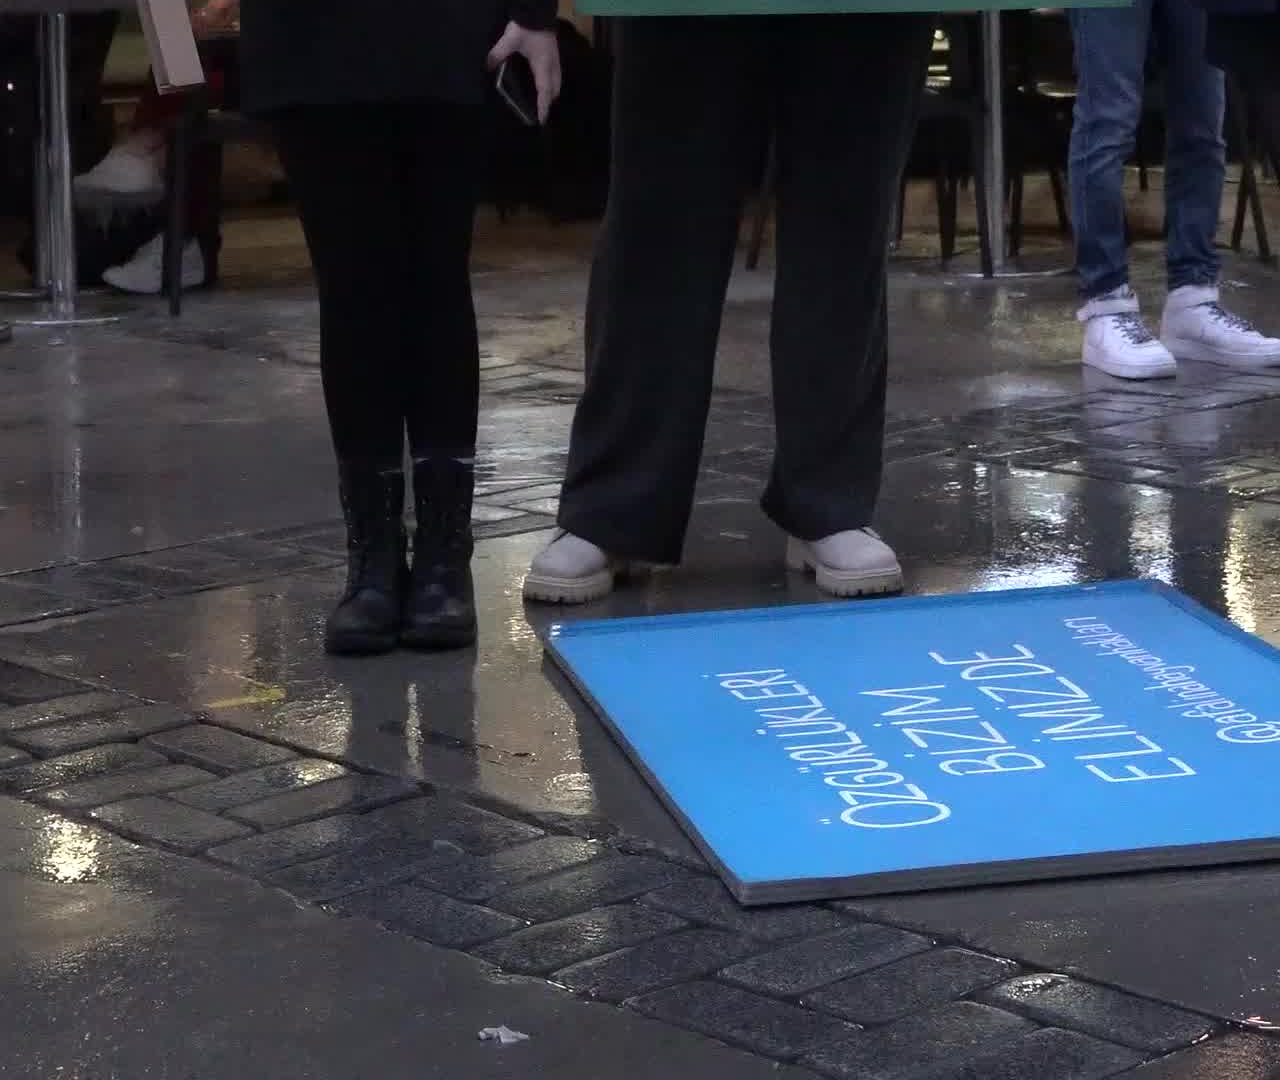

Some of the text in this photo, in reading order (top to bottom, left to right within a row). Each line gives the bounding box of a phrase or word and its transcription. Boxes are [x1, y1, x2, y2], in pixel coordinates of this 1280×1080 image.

[701, 667, 952, 829] ÖZGÜRLÜKLERİ
[857, 683, 1047, 777] BİZİM
[928, 642, 1198, 784] ELİMİZDE
